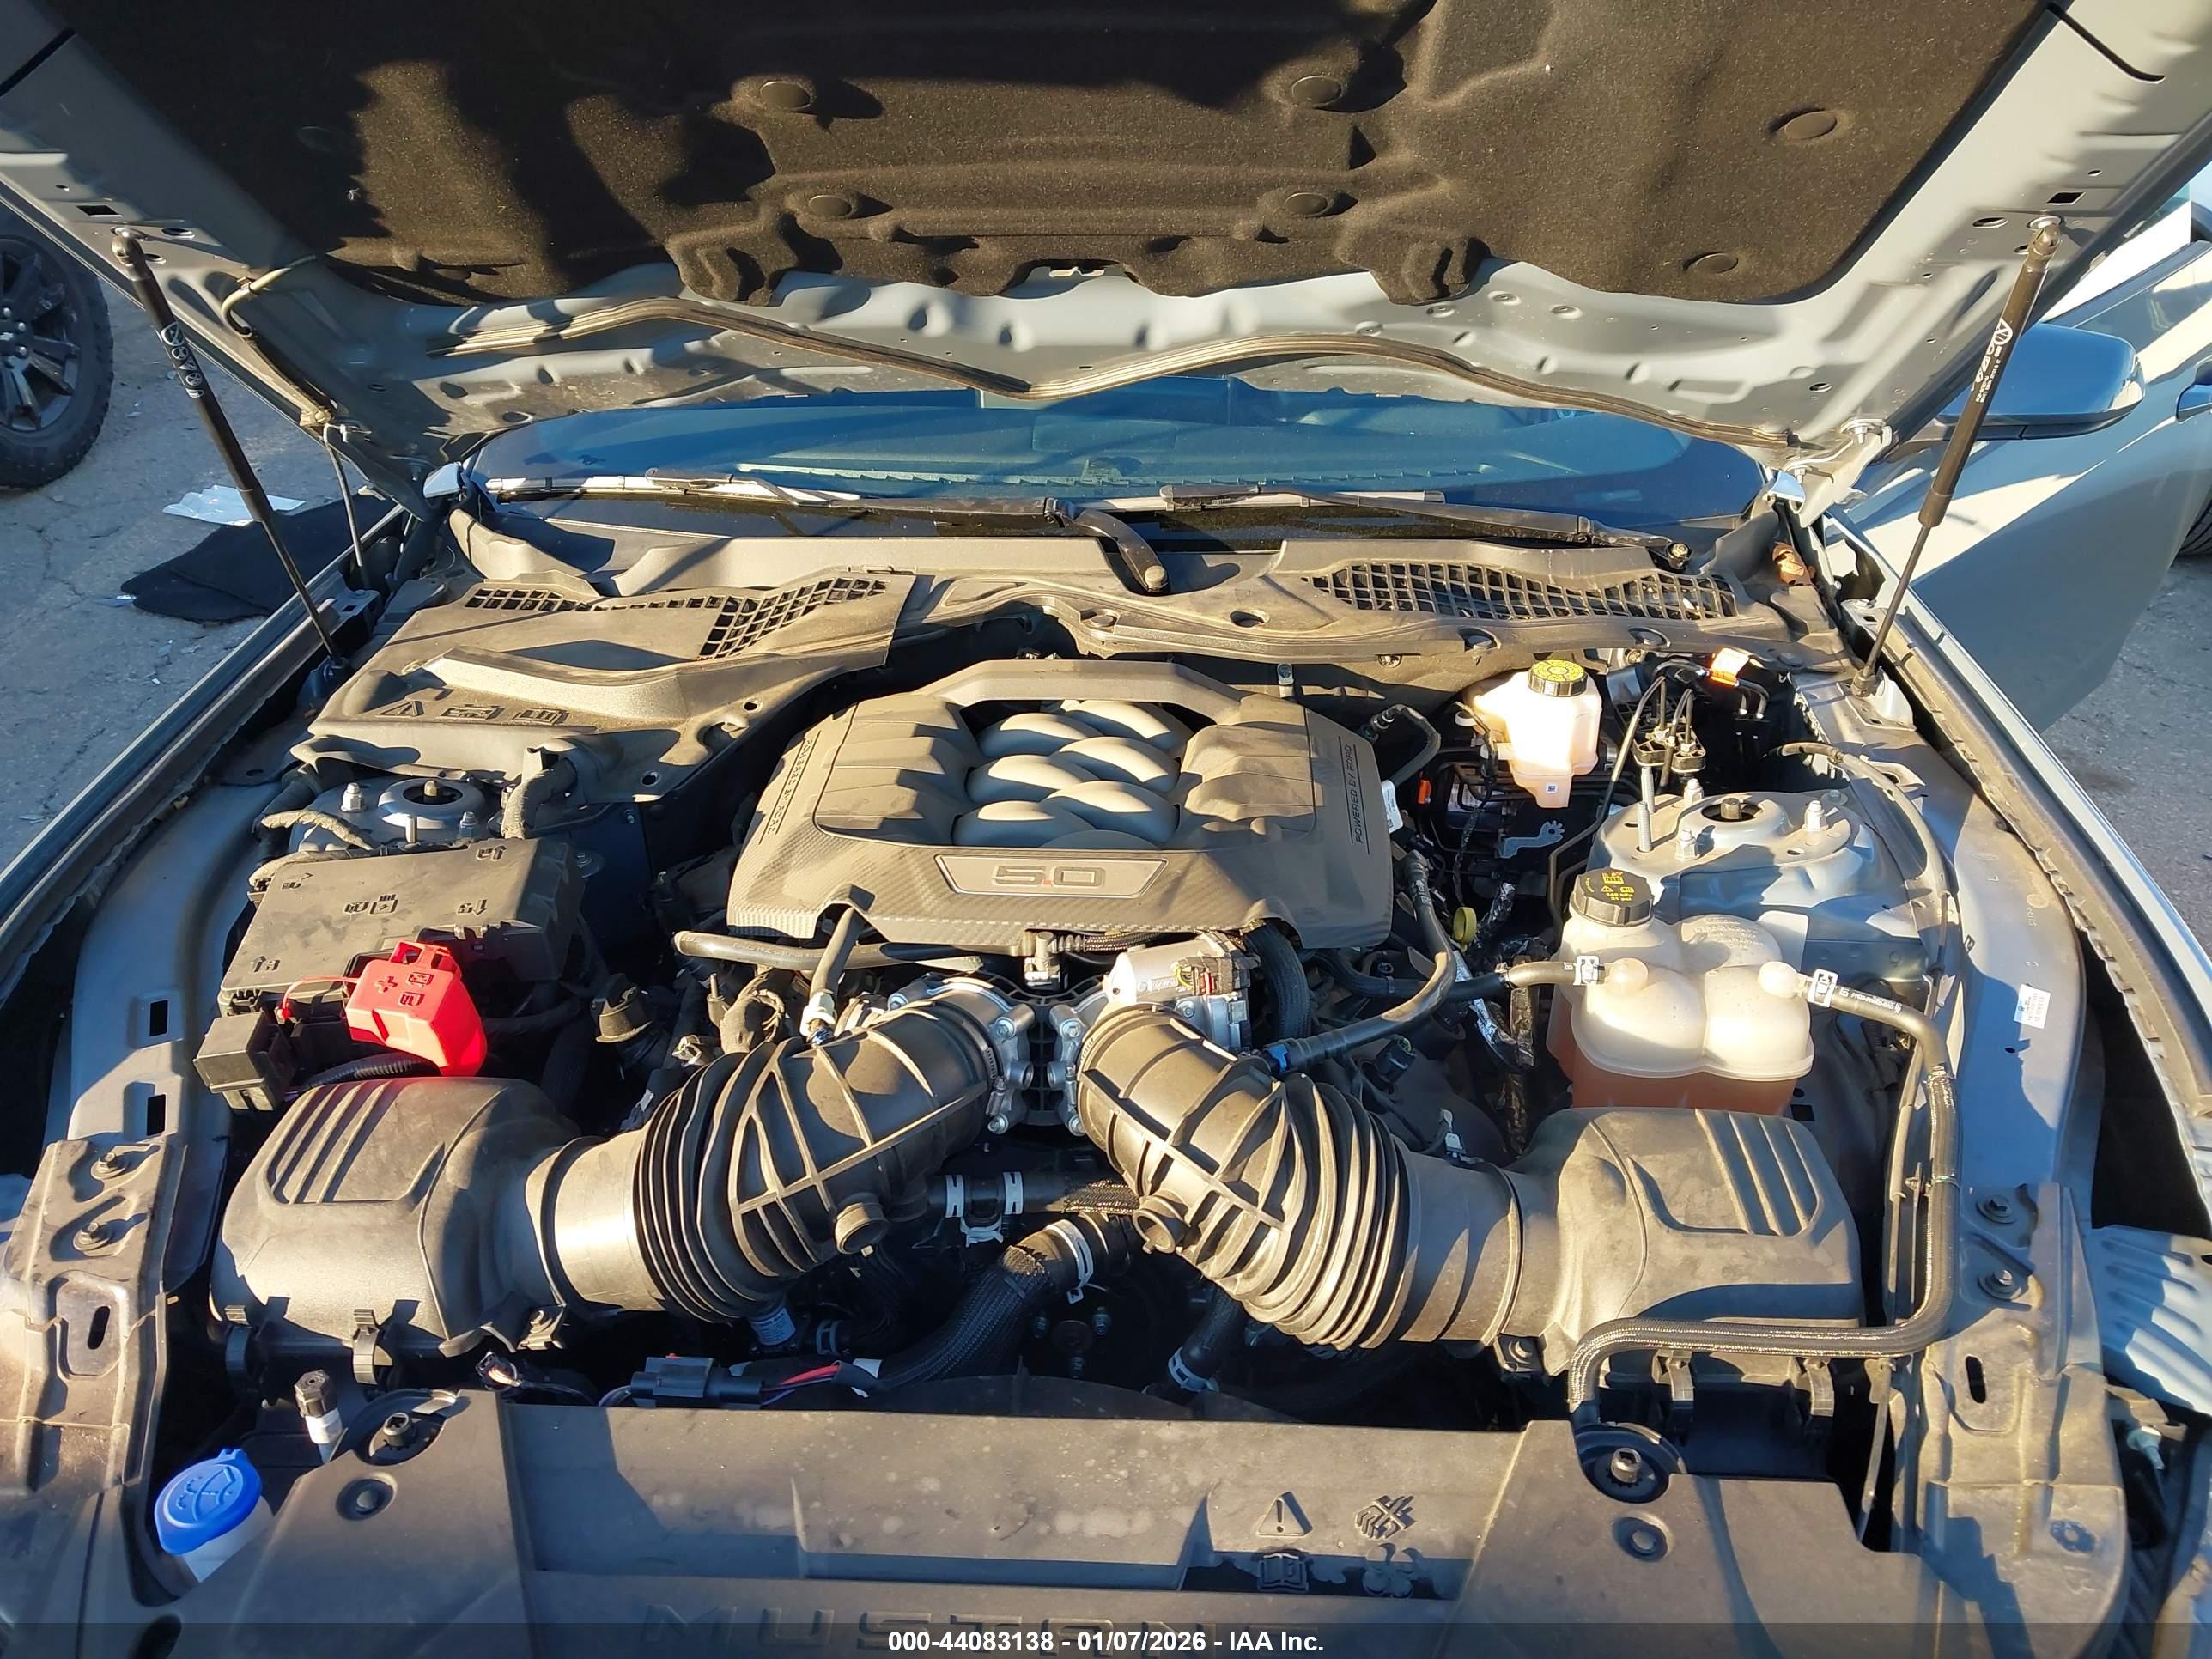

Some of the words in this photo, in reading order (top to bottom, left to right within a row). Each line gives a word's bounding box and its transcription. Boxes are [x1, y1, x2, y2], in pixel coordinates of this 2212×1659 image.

[1345, 745, 1355, 771] FORD
[1349, 789, 1364, 844] POWERED
[993, 865, 1106, 888] 5.0
